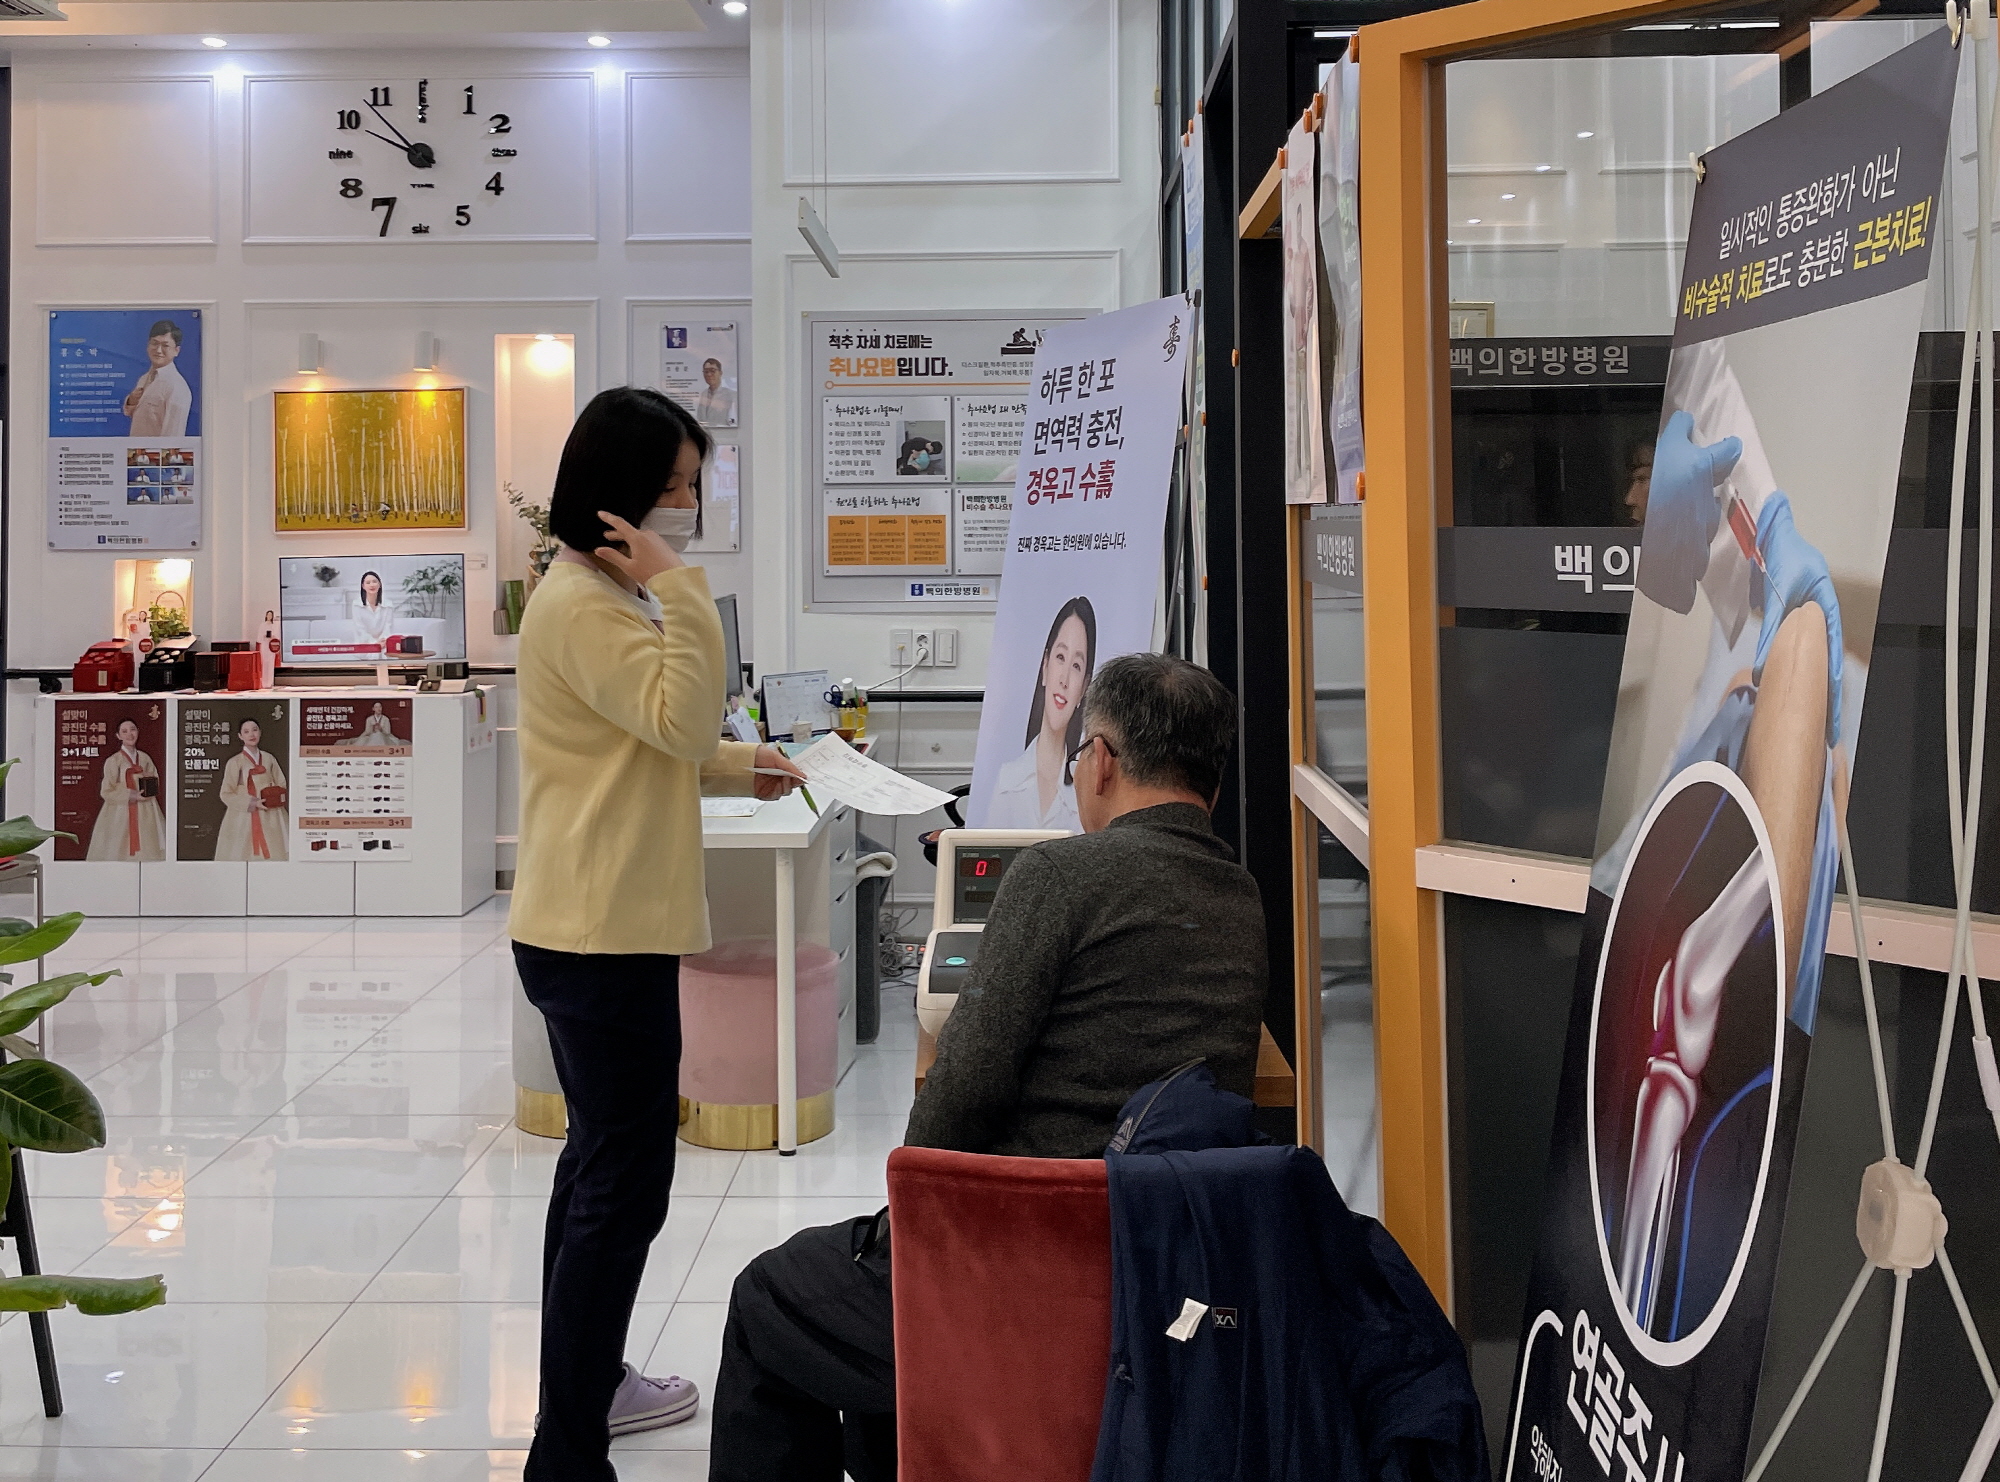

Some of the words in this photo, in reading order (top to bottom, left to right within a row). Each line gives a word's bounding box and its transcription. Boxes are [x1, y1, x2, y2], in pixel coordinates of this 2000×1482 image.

[370, 86, 393, 107] 11
[463, 85, 477, 115] 1
[336, 109, 361, 130] 10
[487, 113, 512, 135] 2
[328, 148, 354, 160] nine
[339, 178, 363, 199] 8
[485, 171, 505, 196] 4
[1719, 200, 1774, 261] 일시적인
[1776, 164, 1856, 240] 통증완화가
[1862, 146, 1901, 204] 아닌
[371, 196, 398, 238] 7
[455, 204, 471, 226] 5
[411, 223, 430, 234] six
[1683, 267, 1735, 320] 비수술적
[1736, 251, 1795, 304] 치료로도
[1797, 227, 1849, 288] 충분한
[1853, 194, 1933, 270] 근본치료!
[828, 334, 854, 350] 척추
[856, 334, 881, 350] 자세
[883, 334, 933, 350] 치료에는
[829, 356, 954, 378] 추나요법입니다.
[1450, 345, 1629, 376] 백의한방병원
[1040, 364, 1073, 405] 하루
[1077, 359, 1095, 400] 한
[1096, 358, 1117, 393] 포
[835, 404, 871, 418] 추나요법은
[967, 403, 996, 417] 추나요법
[1034, 412, 1083, 456] 면역력
[1086, 406, 1125, 450] 충전,
[1026, 466, 1077, 506] 경옥고
[966, 503, 986, 511] 비수술
[1034, 535, 1061, 552] 경옥고는
[1063, 533, 1093, 551] 한의원에
[1094, 531, 1126, 550] 있습니다.
[1316, 533, 1355, 577] 백의한방병원
[926, 587, 980, 596] 백의한방병원
[62, 710, 88, 720] 설맞이
[185, 709, 211, 720] 설맞이
[62, 747, 80, 757] 3+1
[81, 746, 99, 757] 세트
[184, 747, 205, 757] 20%
[185, 759, 220, 770] 단품할인
[975, 861, 988, 876] 0
[1567, 1309, 1686, 1482] 연골주
